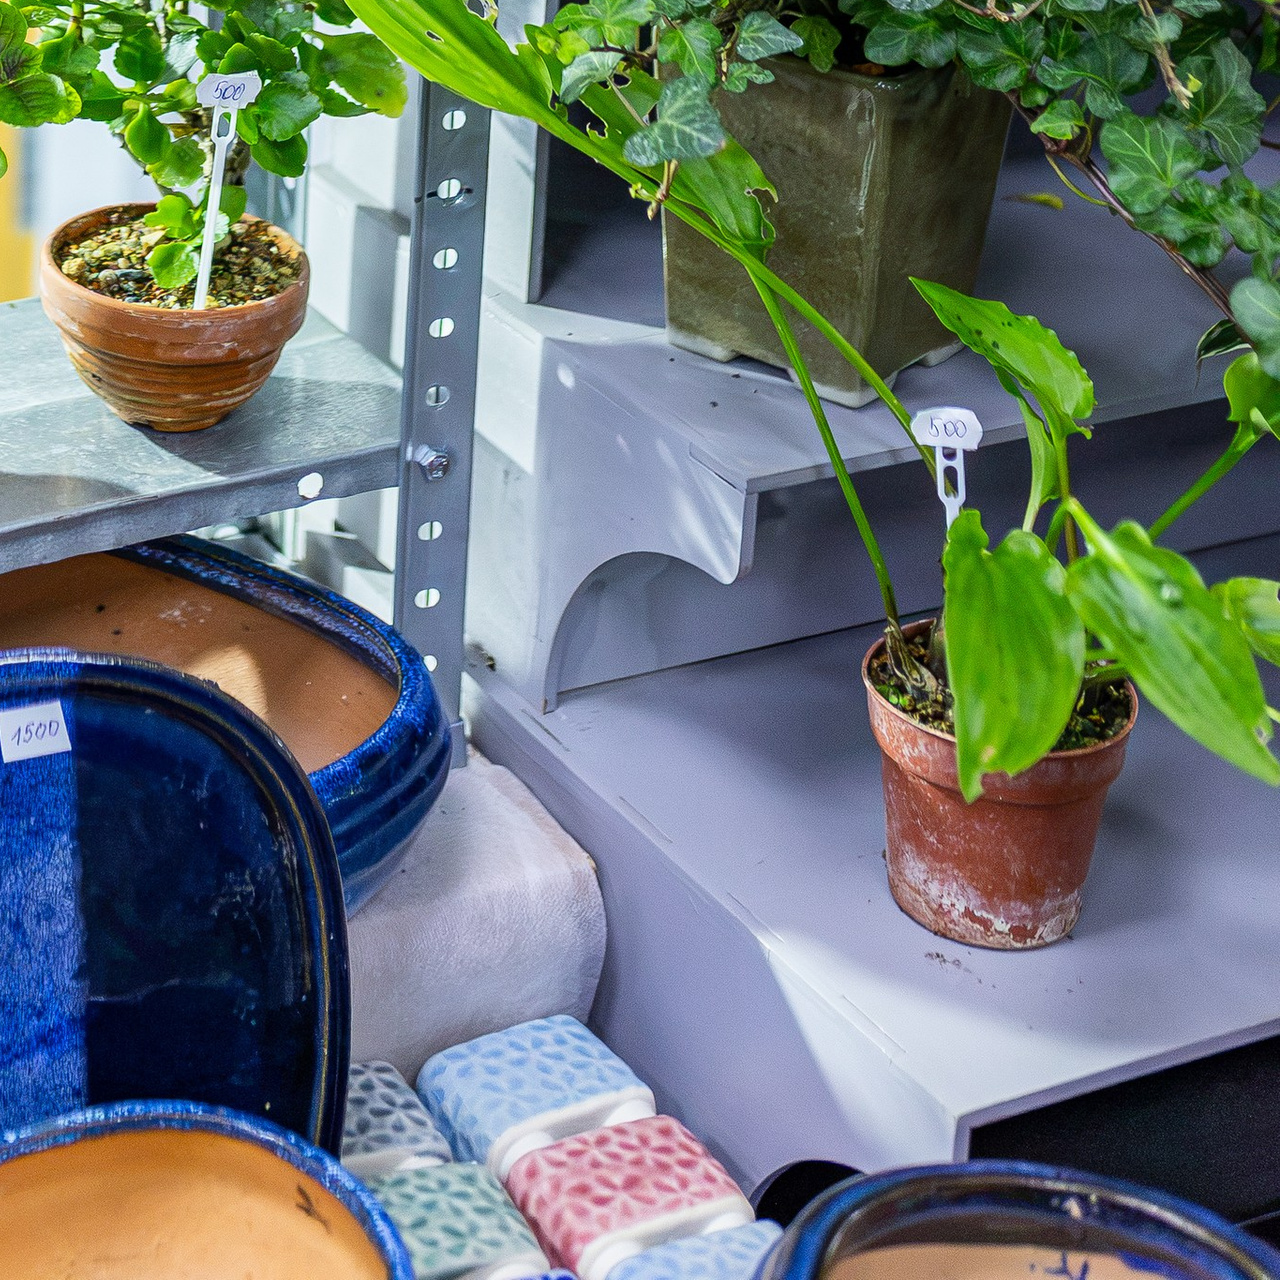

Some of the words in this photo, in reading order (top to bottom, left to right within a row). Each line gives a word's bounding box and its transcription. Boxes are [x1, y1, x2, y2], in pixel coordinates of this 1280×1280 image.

[212, 80, 246, 101] 500
[928, 416, 968, 439] 500
[11, 719, 60, 747] 1500
